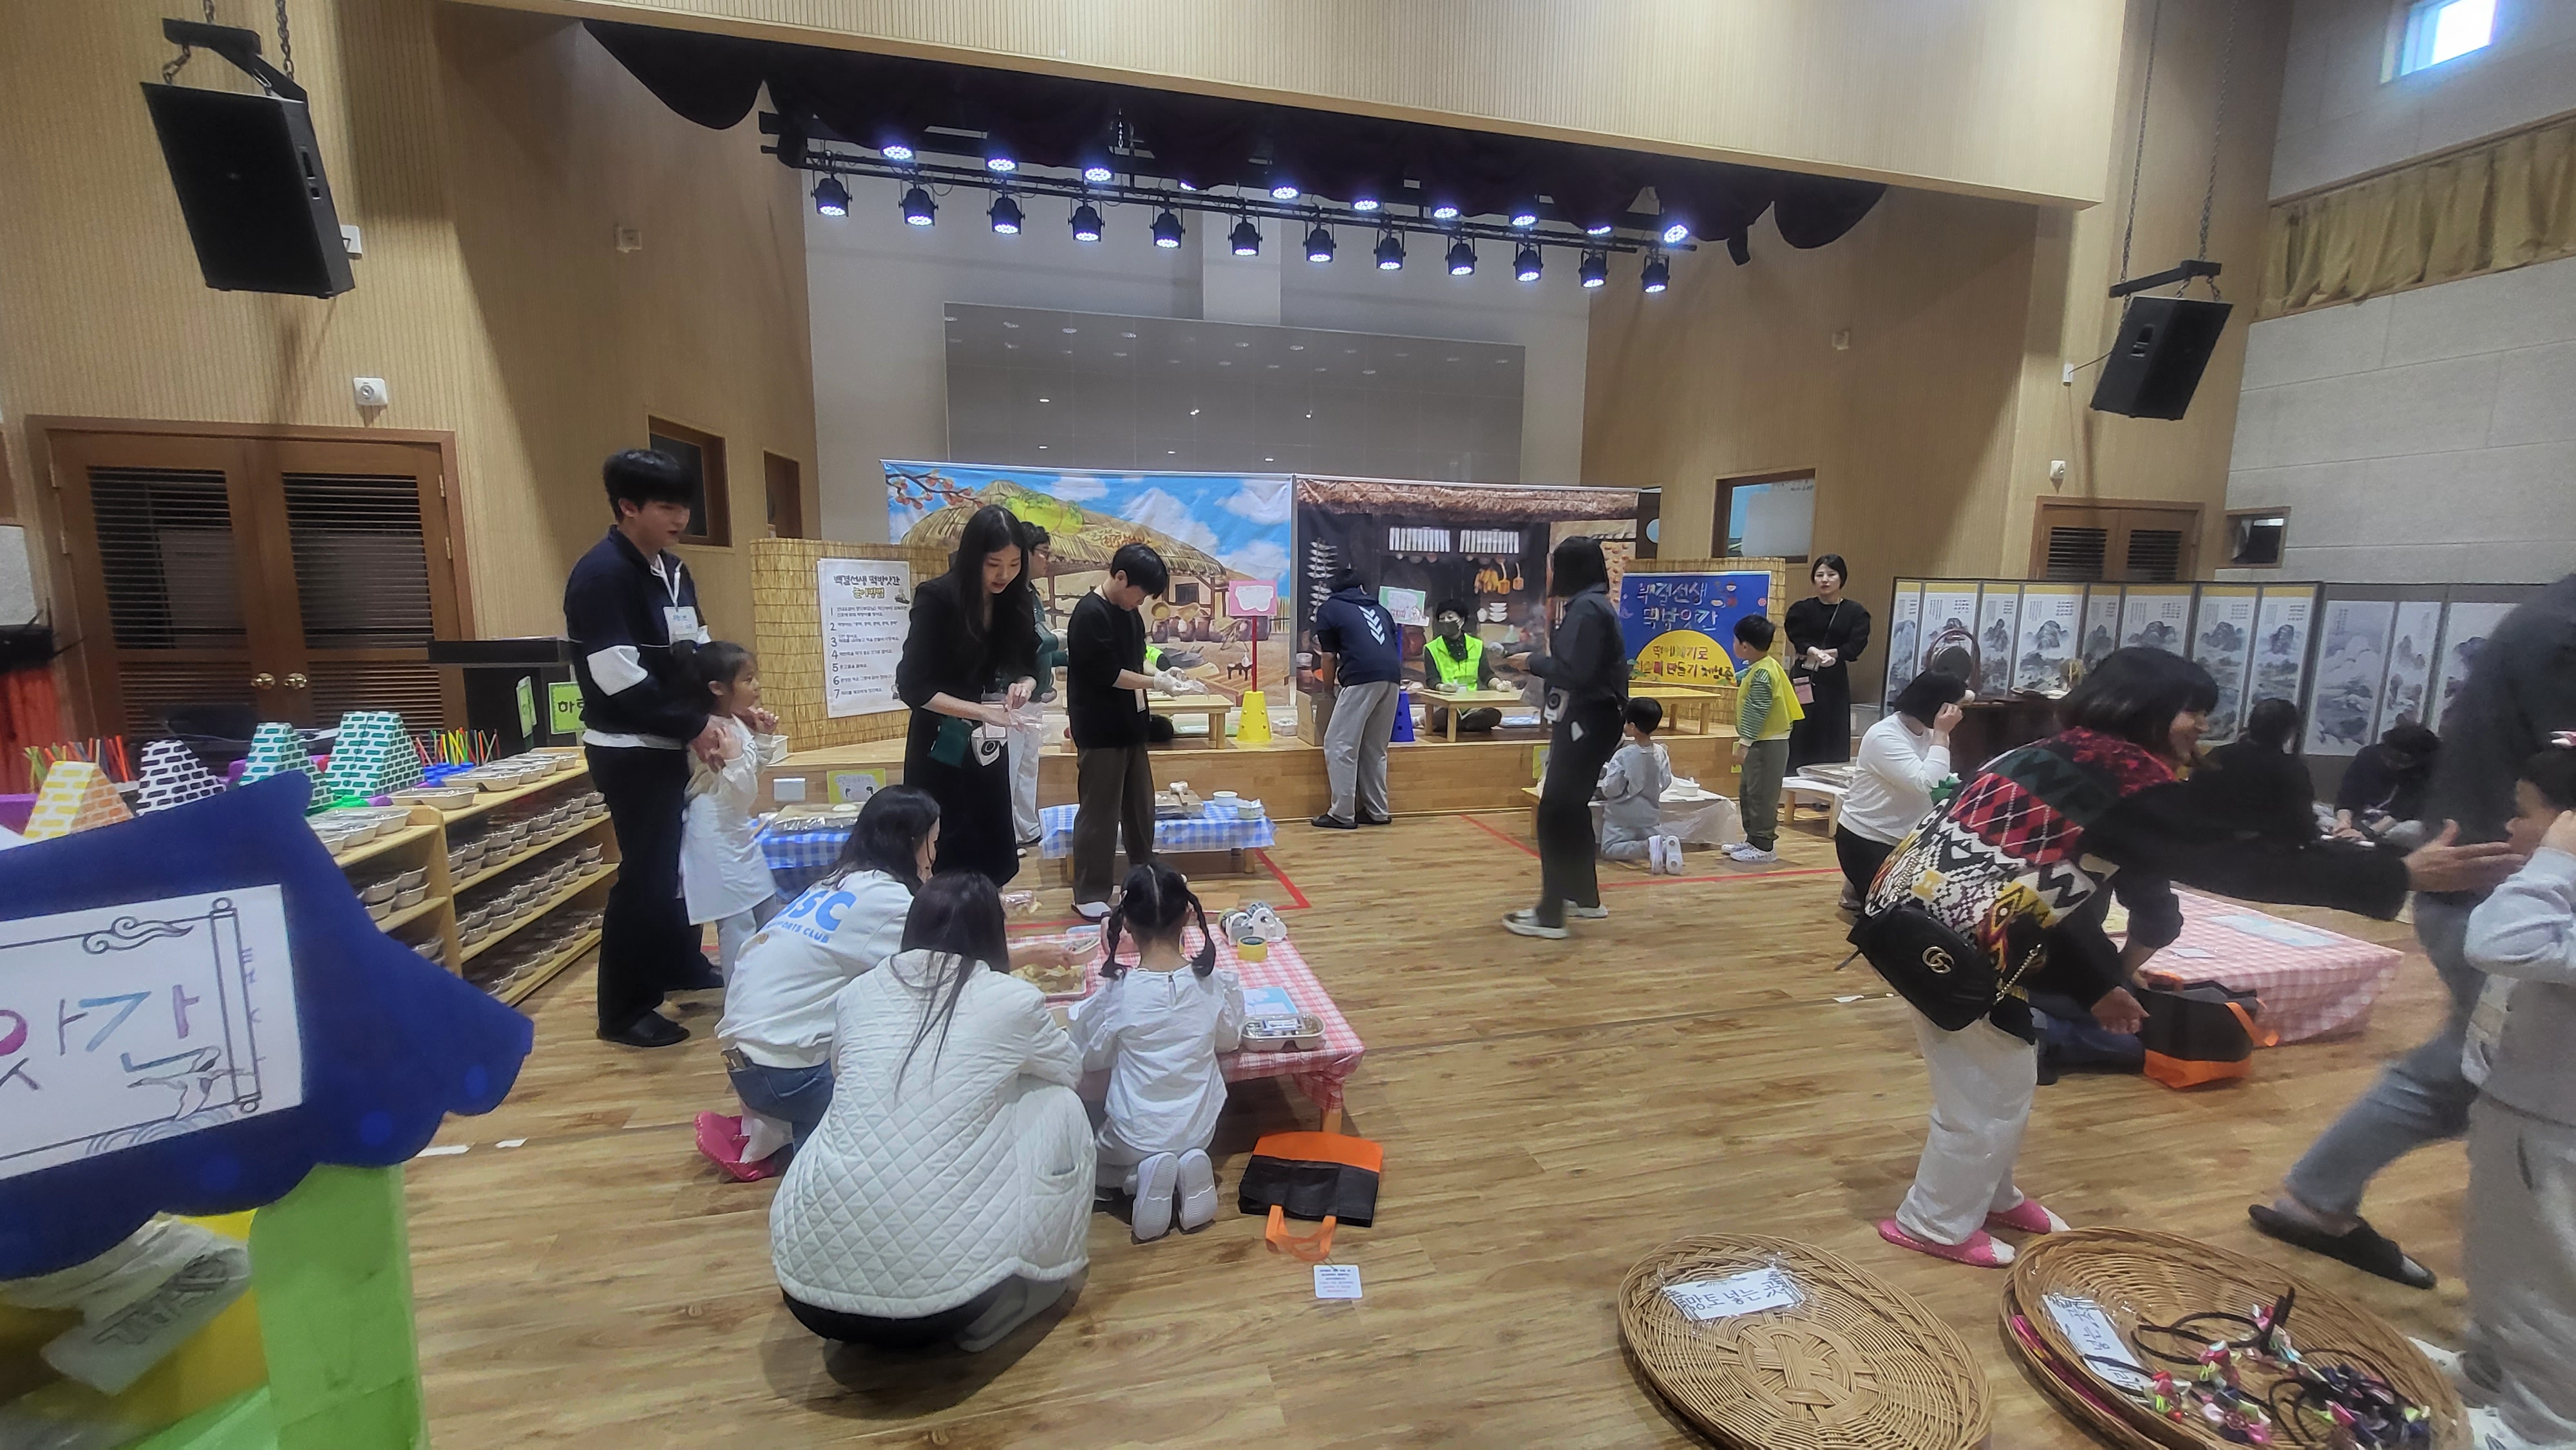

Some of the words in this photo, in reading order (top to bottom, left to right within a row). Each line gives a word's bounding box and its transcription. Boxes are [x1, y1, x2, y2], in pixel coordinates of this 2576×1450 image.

[833, 575, 867, 586] 백결선생
[869, 575, 901, 586] 떡방앗간
[852, 587, 885, 599] 놀이방법
[1636, 581, 1708, 605] 백결선생
[1643, 607, 1719, 631] 떡방앗간
[829, 622, 837, 631] 2
[830, 636, 837, 647] 3
[831, 650, 838, 659] 4
[832, 663, 838, 672] 5
[833, 675, 840, 685] 6
[833, 689, 840, 699] 7
[803, 928, 830, 943] CLUB
[1685, 1293, 1725, 1311] 망토
[1723, 1288, 1762, 1305] 넣는
[1761, 1281, 1784, 1298] 곳
[2083, 1326, 2111, 1351] 넣는
